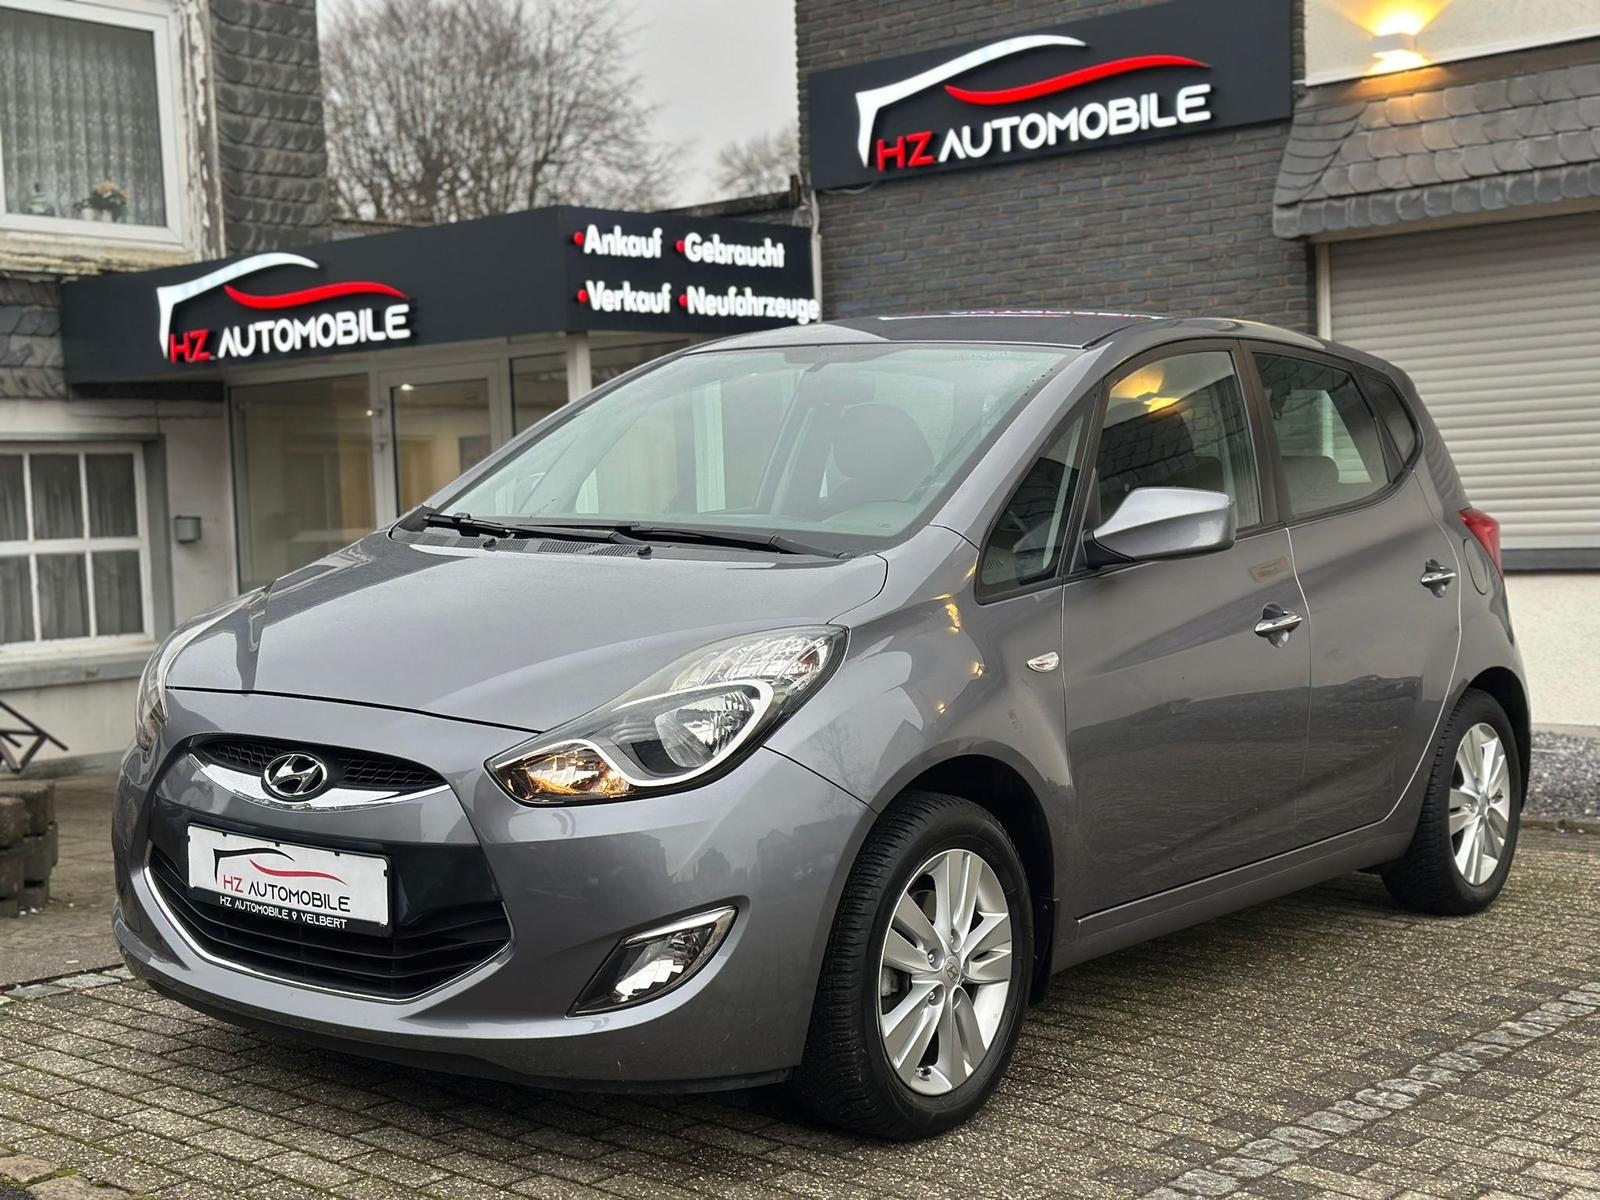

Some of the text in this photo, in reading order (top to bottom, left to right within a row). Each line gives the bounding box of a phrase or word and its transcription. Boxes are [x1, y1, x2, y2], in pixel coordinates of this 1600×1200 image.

[876, 83, 1212, 171] HZ AUTOMOBILE
[583, 224, 786, 268] Ankauf Gebraucht
[585, 280, 820, 326] Verkauf Neufahrzeuge
[169, 303, 411, 364] HZ AUTOMOBILE
[220, 895, 347, 928] HZ AUTOMOBILE VELBERT
[223, 874, 350, 912] HZ AUTOMOBILE
